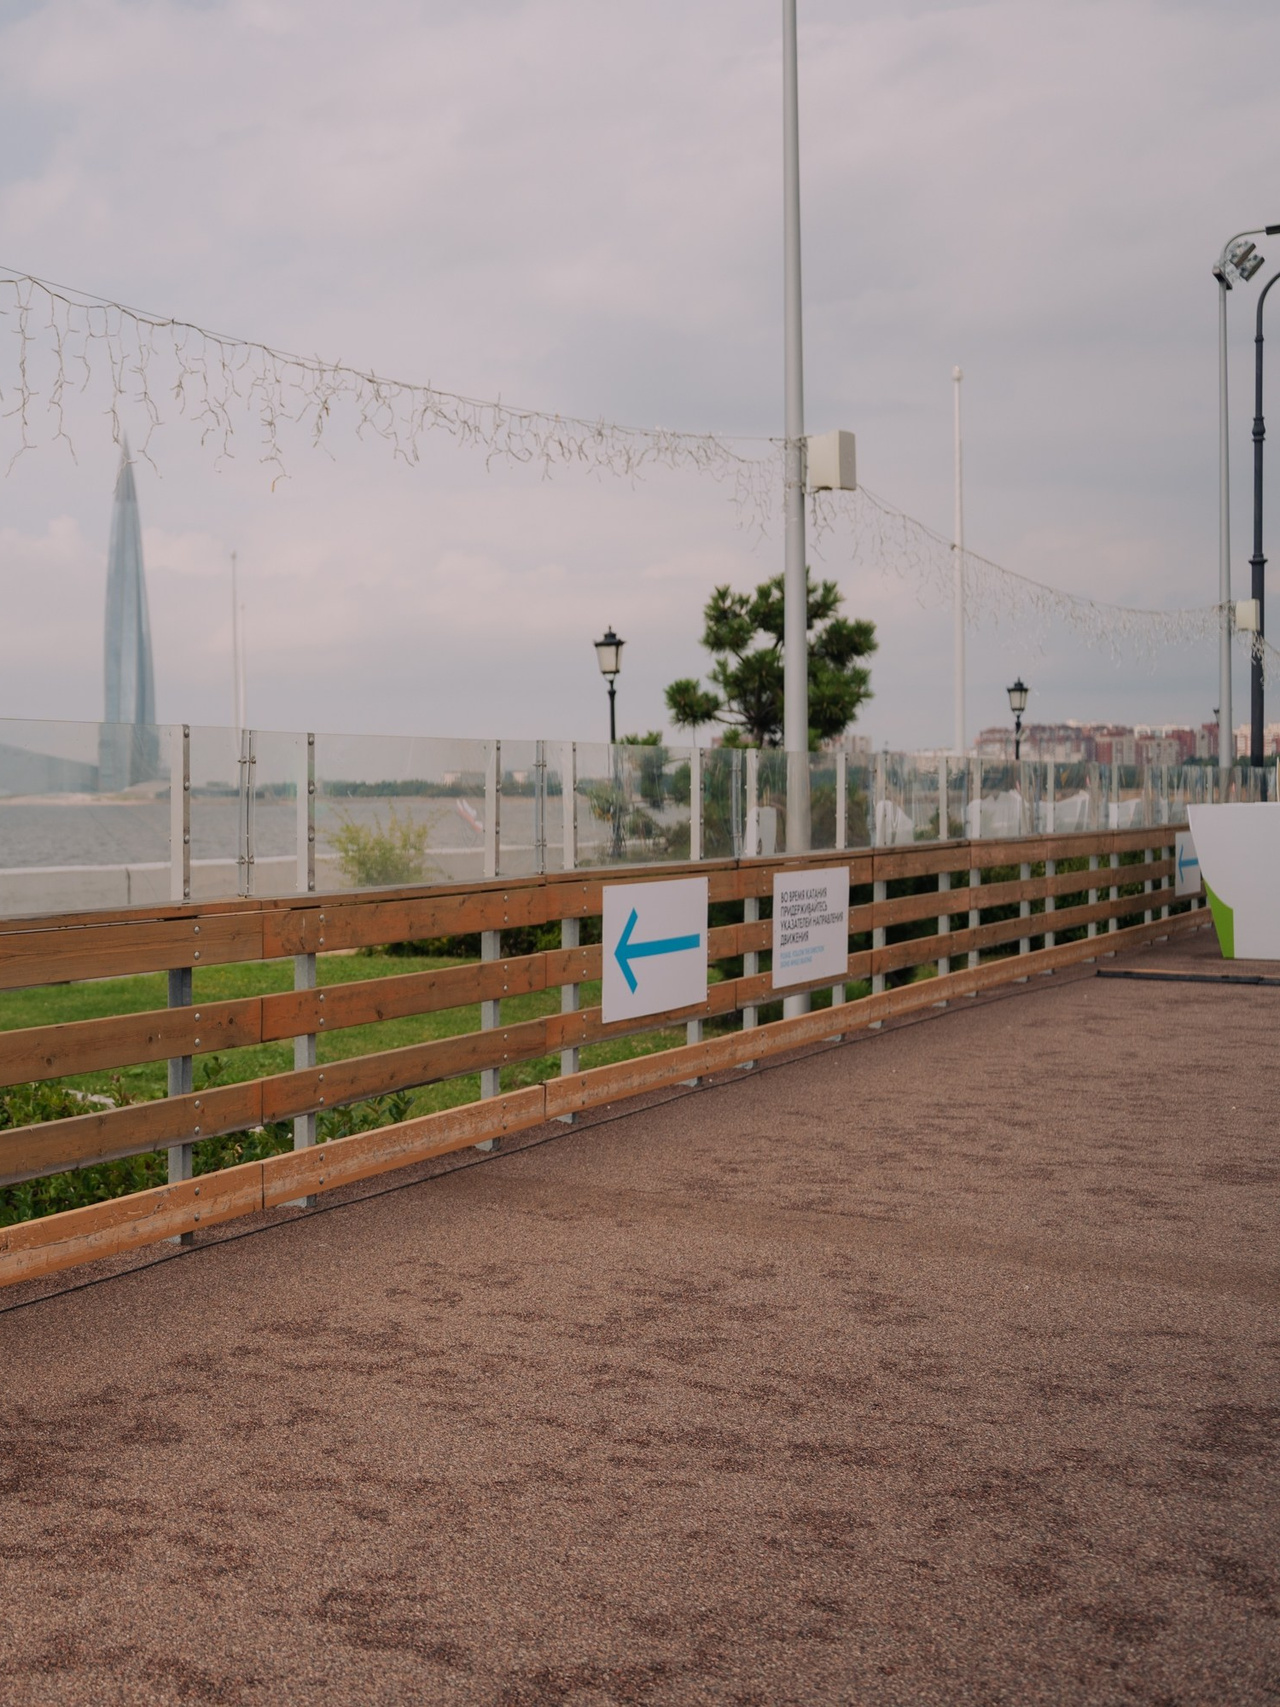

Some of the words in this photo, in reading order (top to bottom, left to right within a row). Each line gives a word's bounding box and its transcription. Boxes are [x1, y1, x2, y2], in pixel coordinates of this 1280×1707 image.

[780, 891, 789, 904] ВО
[789, 889, 805, 902] ВРЕМЯ
[805, 887, 828, 900] КАТАНИЯ
[780, 900, 828, 917] ПРИДЕРЖИВАЙТЕСЬ
[780, 914, 812, 931] УКАЗАТЕЛЕЙ
[813, 912, 844, 925] НАПРАВЛЕНИЯ
[780, 931, 809, 947] ДВИЖЕНИЯ
